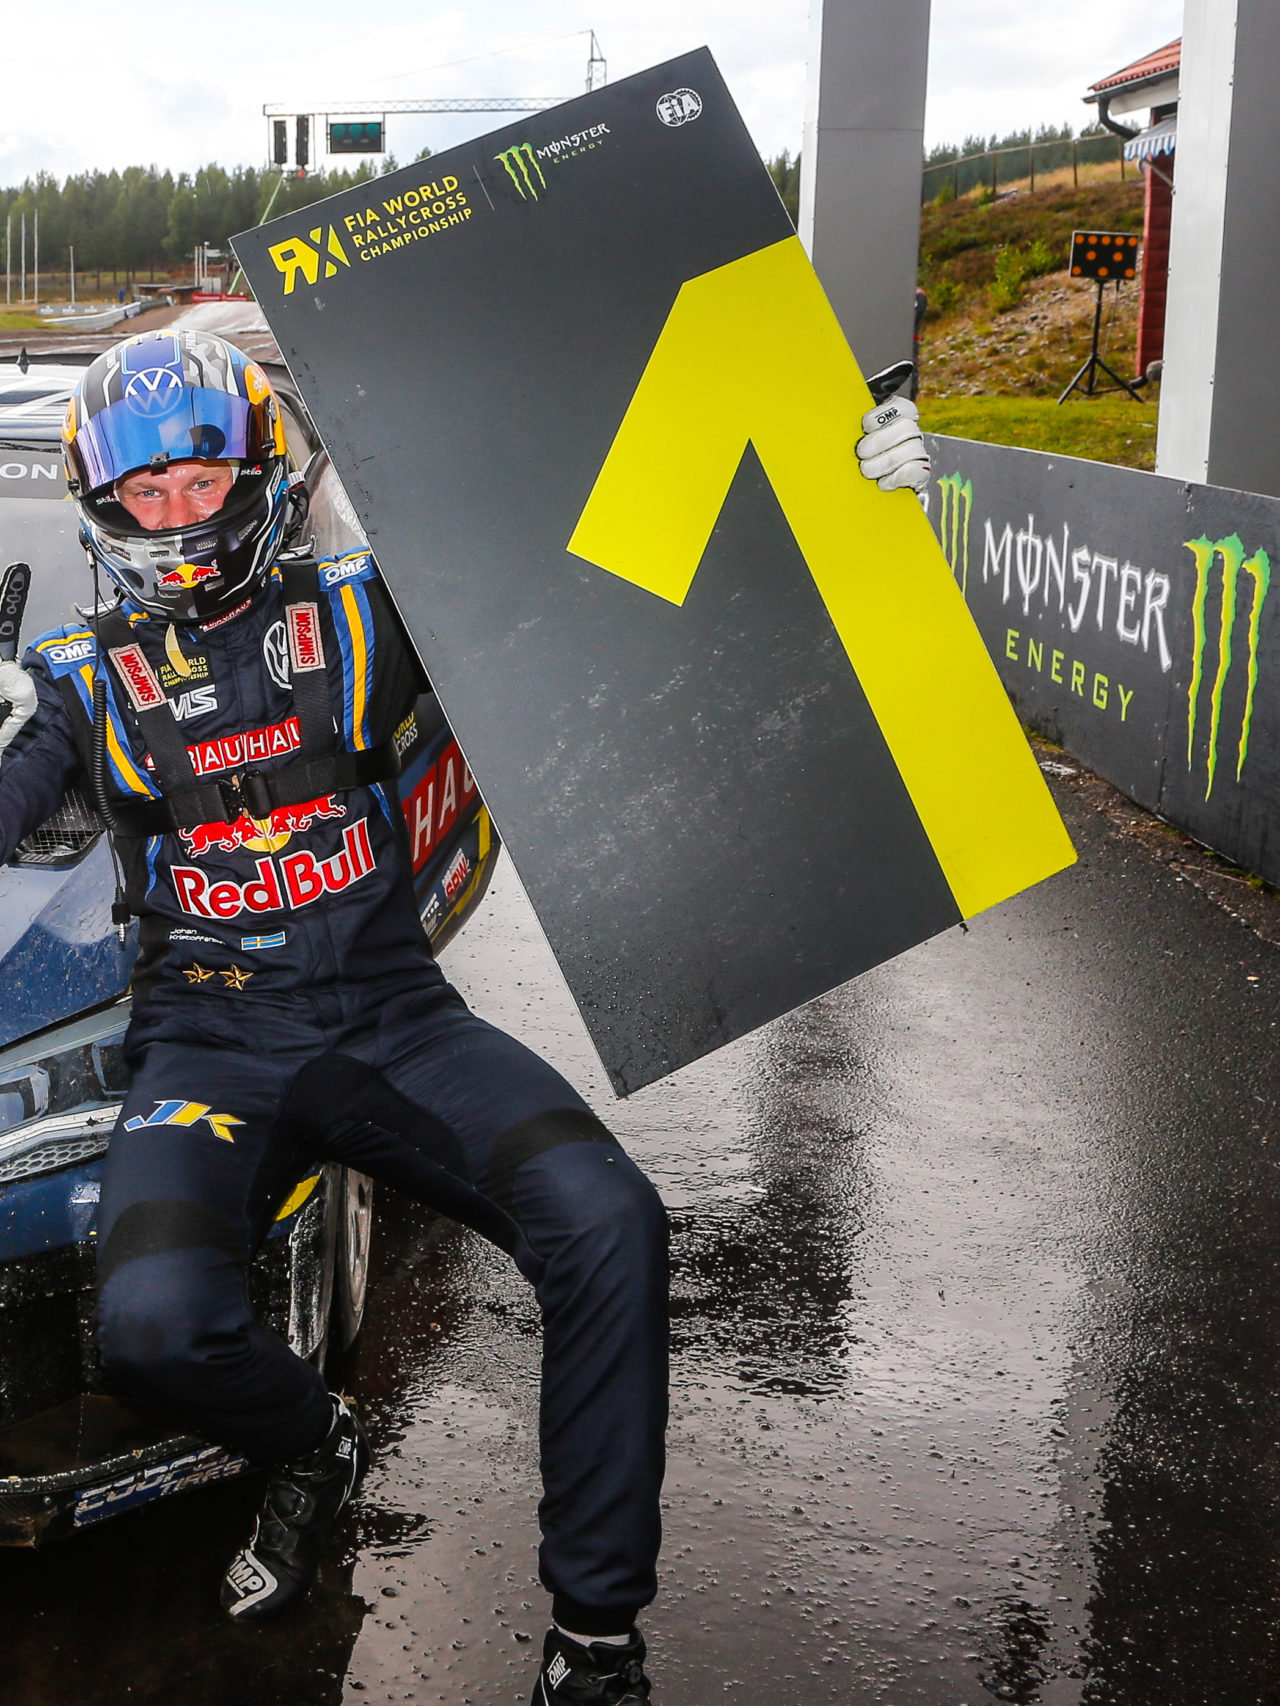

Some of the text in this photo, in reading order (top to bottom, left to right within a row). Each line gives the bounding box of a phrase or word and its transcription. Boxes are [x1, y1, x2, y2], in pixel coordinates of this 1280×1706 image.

[536, 123, 611, 160] MONSTER
[553, 139, 604, 164] ENERGY
[343, 175, 459, 232] FIA WORLD
[352, 192, 468, 248] RALLYCROSS
[360, 207, 473, 261] CHAMPIONSHIP
[877, 408, 900, 426] OMP
[326, 558, 367, 583] OMP
[982, 513, 1172, 673] MONSTER
[49, 643, 93, 662] OMP
[295, 611, 316, 665] SIMPSON
[120, 652, 157, 704] SIMPSON
[1005, 628, 1134, 722] ENERGY
[170, 856, 284, 919] Red
[279, 817, 377, 910] Bull
[548, 1658, 567, 1686] OMP
